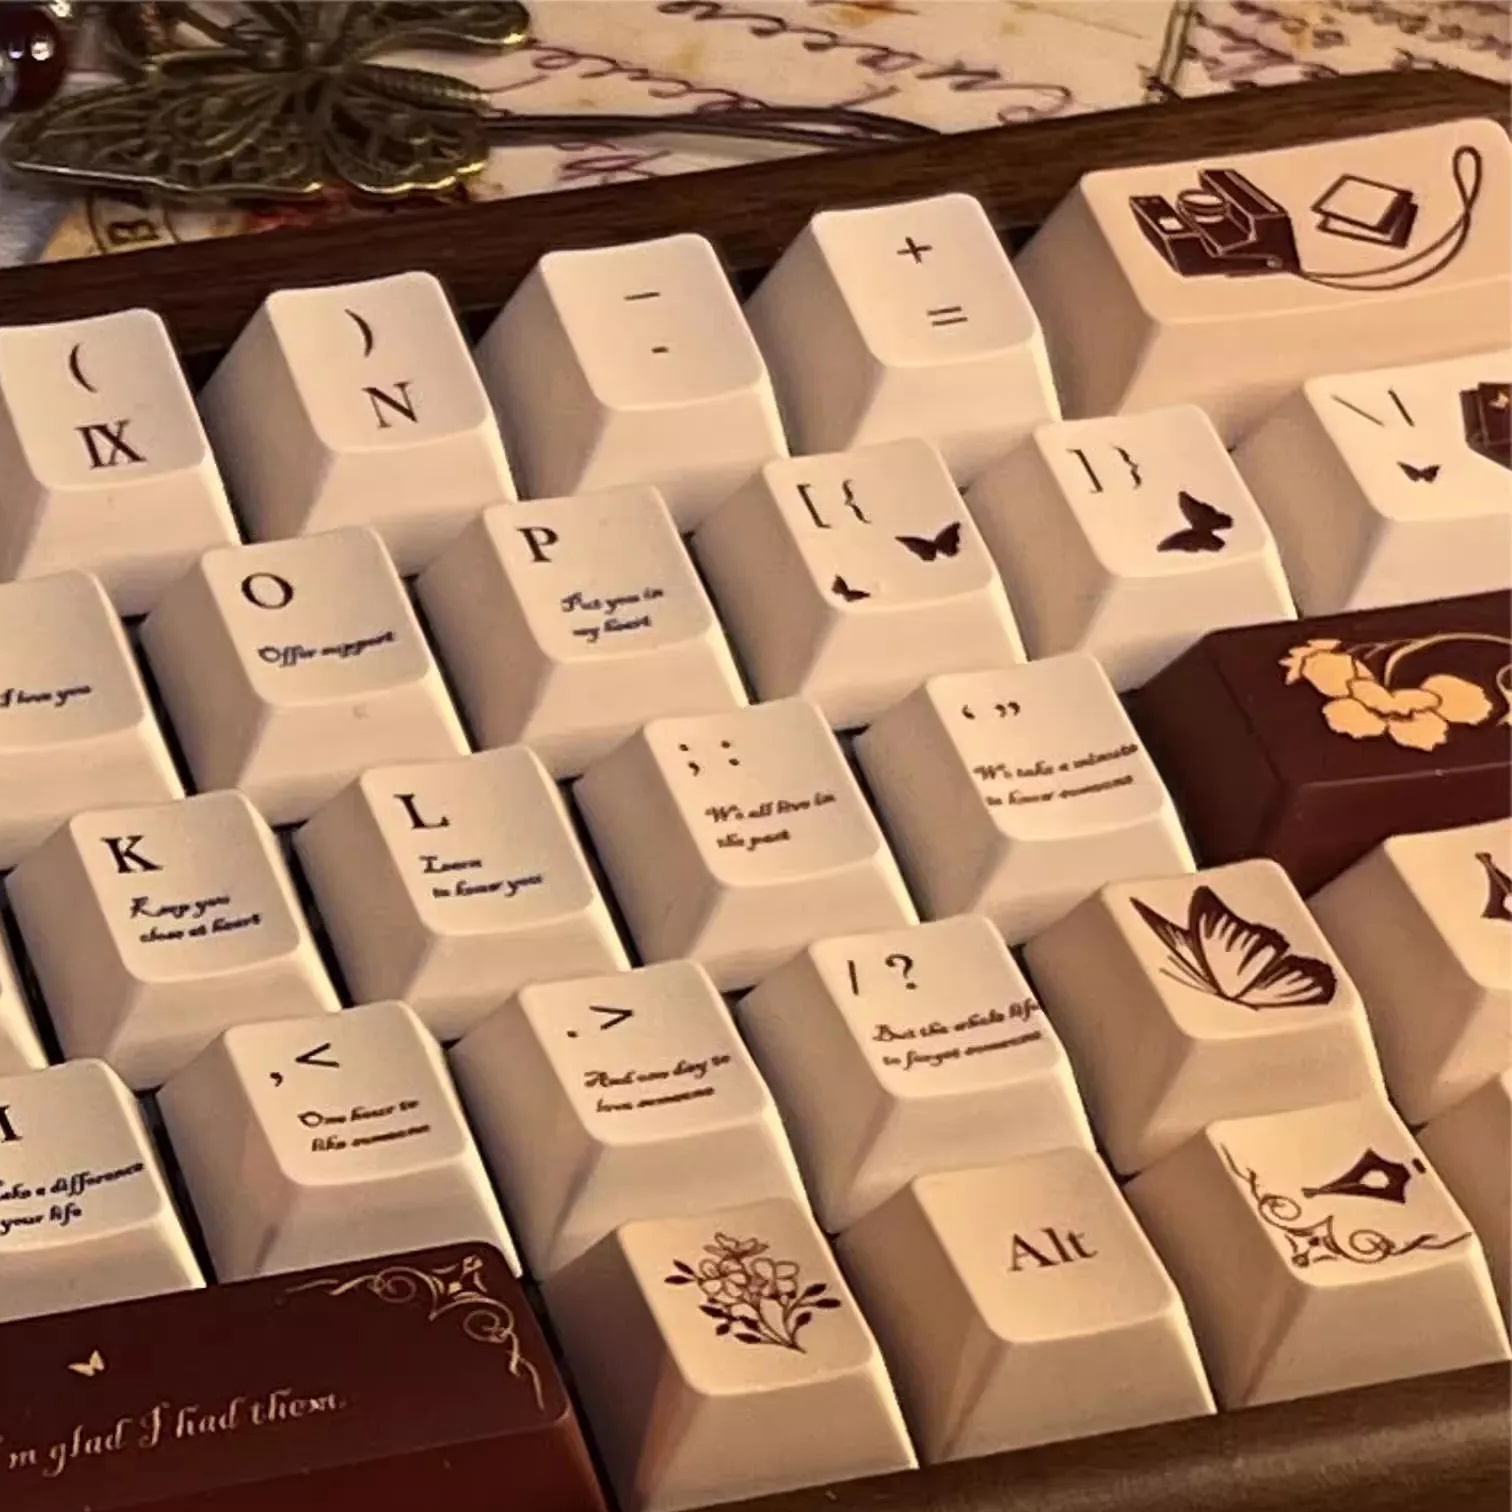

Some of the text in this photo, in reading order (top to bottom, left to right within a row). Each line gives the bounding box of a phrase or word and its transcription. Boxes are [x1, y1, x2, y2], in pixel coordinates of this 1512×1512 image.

[896, 236, 933, 264] +
[926, 305, 968, 327] =
[345, 308, 373, 357] )
[69, 343, 98, 393] (
[362, 381, 418, 428] N
[76, 420, 147, 470] IX
[518, 527, 560, 563] P
[241, 572, 294, 610] O
[604, 592, 641, 616] you
[603, 613, 652, 634] heart
[257, 630, 395, 668] Offer support
[54, 685, 92, 708] you
[1071, 742, 1139, 771] minute
[395, 793, 450, 830] L
[102, 834, 163, 874] K
[419, 855, 482, 875] Learn
[504, 873, 544, 897] you
[129, 893, 231, 919] Keep you
[211, 912, 261, 934] heart
[885, 953, 918, 990] ?
[588, 1005, 633, 1031] >
[871, 1022, 916, 1043] But
[294, 1041, 340, 1068] <
[903, 1047, 962, 1071] forget
[584, 1059, 708, 1089] And day
[297, 1104, 395, 1129] One hour
[48, 1160, 145, 1196] difference
[47, 1202, 83, 1226] life
[1006, 1226, 1098, 1274] Alt
[42, 1416, 132, 1478] glad
[138, 1399, 170, 1448] I
[175, 1396, 246, 1439] had
